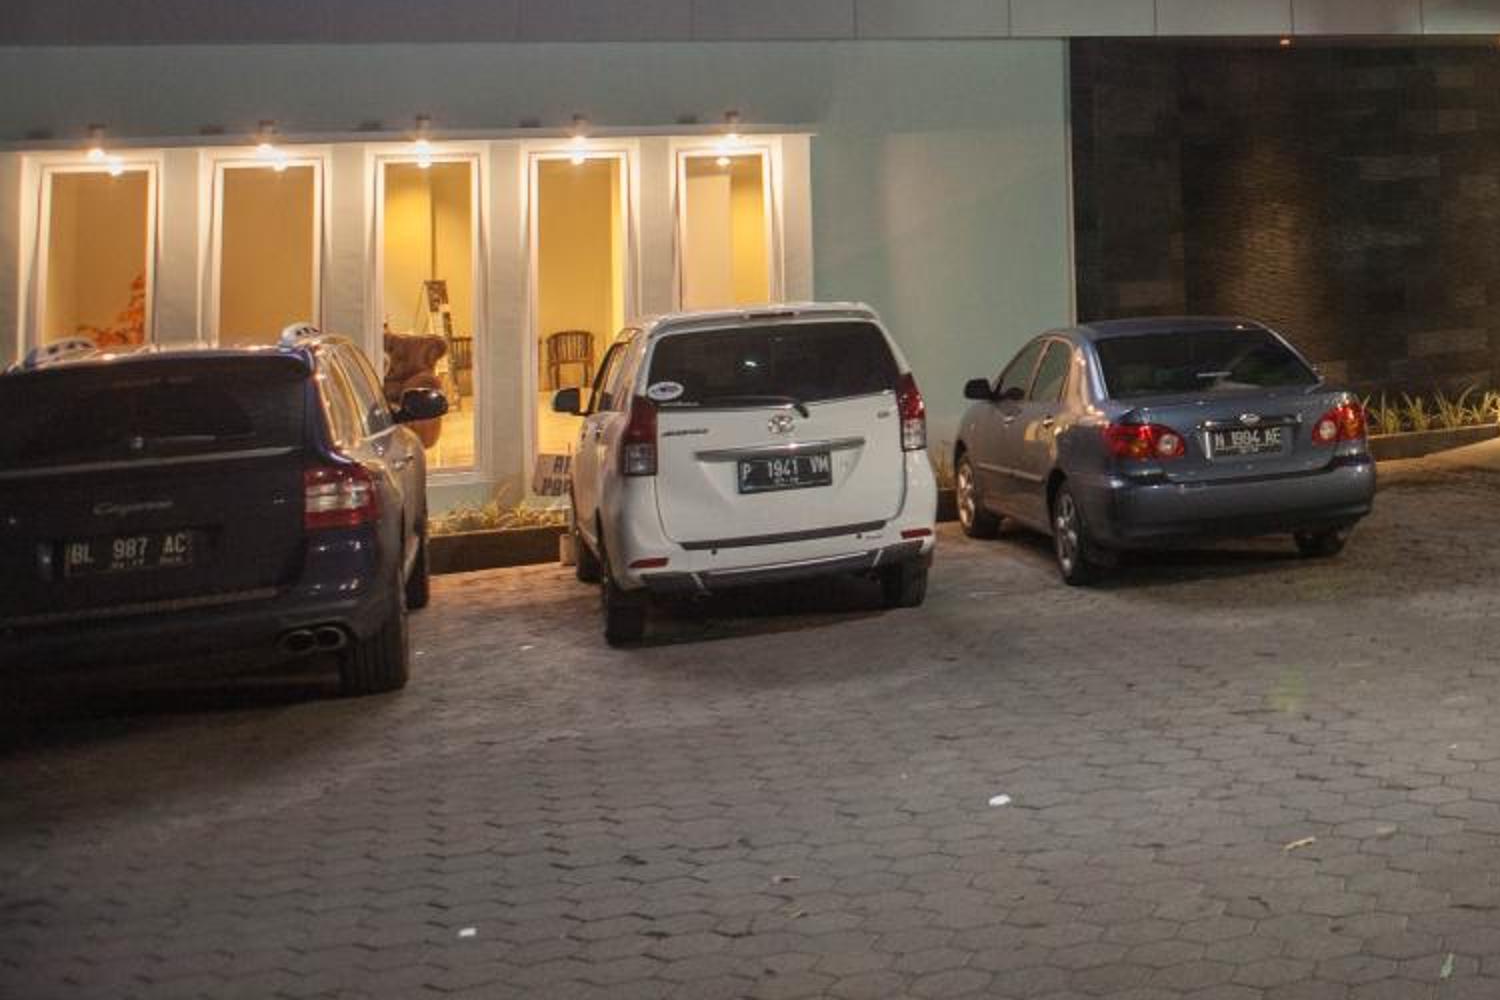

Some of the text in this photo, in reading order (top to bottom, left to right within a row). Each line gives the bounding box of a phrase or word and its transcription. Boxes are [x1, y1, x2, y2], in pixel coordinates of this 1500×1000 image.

[742, 462, 752, 481] P
[767, 458, 799, 479] 1941
[112, 537, 148, 560] 987
[163, 533, 186, 554] AC
